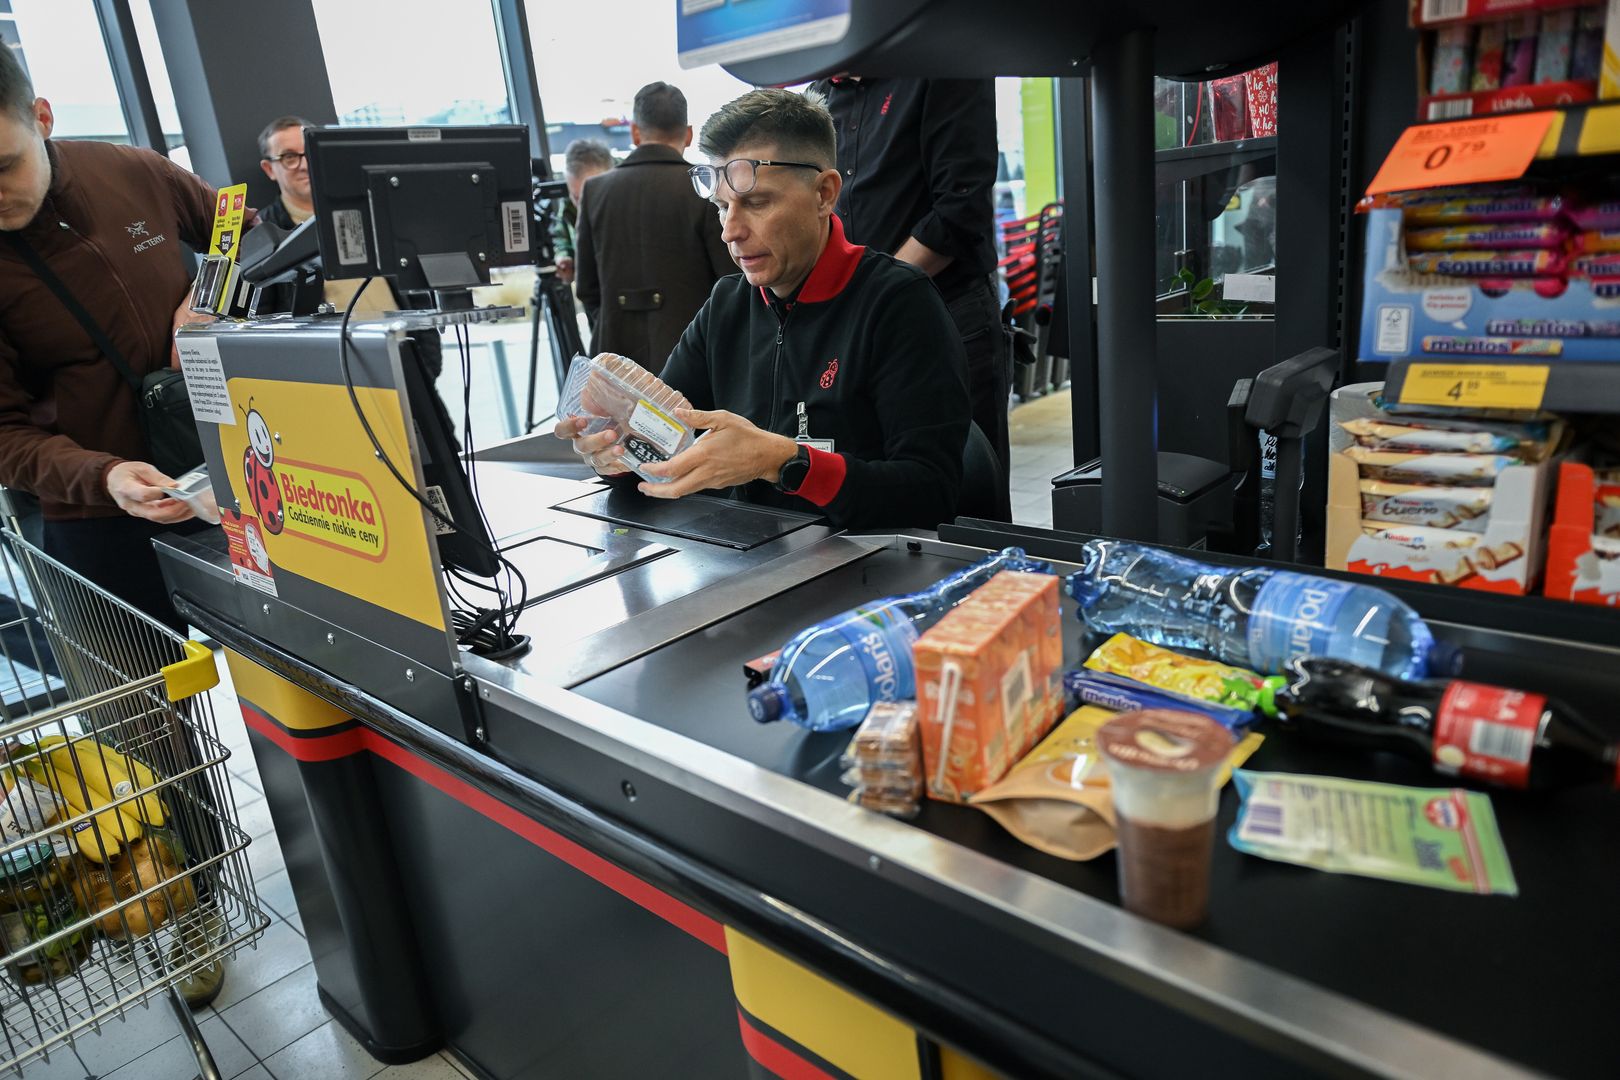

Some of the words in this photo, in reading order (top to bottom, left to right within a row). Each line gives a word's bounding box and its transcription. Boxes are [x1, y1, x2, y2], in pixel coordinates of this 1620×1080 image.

[1424, 145, 1452, 170] 0
[1437, 259, 1534, 275] mentos
[1489, 319, 1585, 337] mentos
[1430, 338, 1510, 353] mentos
[1447, 380, 1463, 401] 4
[280, 472, 376, 526] Biedronka
[1382, 502, 1439, 516] bueno
[287, 506, 331, 531] Codziennie
[332, 518, 357, 539] niskie
[358, 529, 379, 549] ceny
[1083, 688, 1141, 711] mentos
